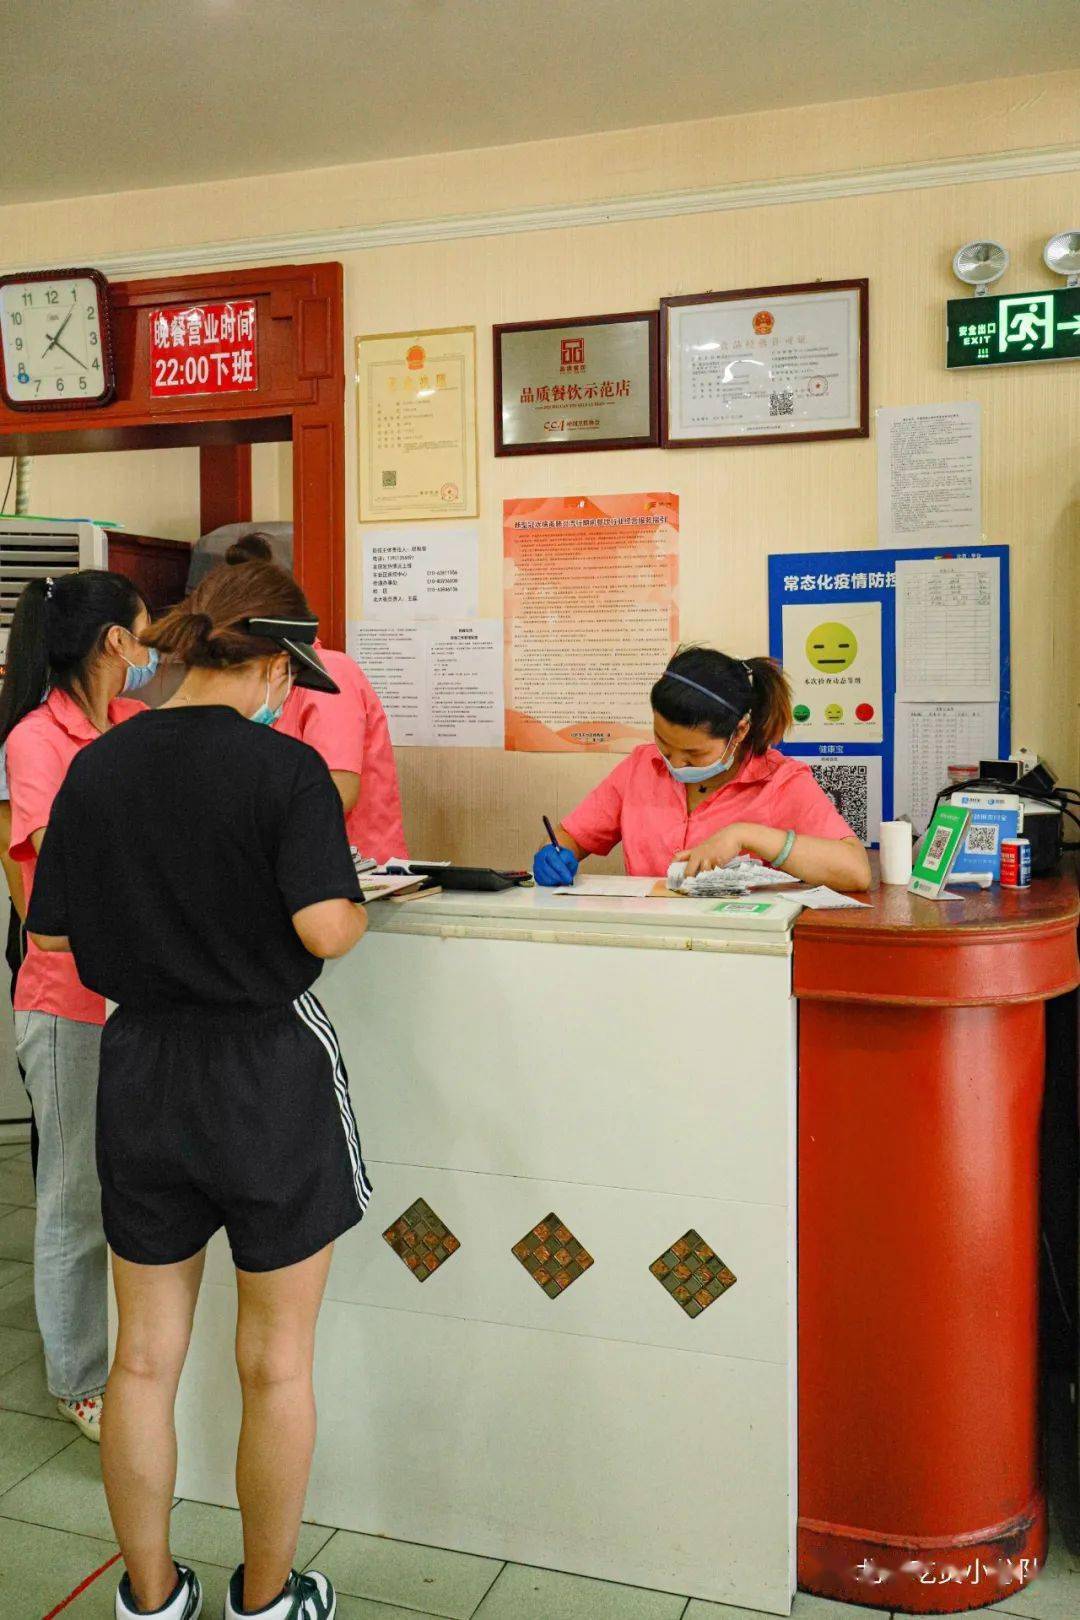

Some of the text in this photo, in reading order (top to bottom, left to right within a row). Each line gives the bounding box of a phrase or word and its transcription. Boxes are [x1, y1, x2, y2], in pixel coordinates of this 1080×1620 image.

[22, 292, 34, 306] 11
[45, 290, 59, 305] 12
[11, 311, 22, 326] 10
[87, 307, 95, 319] 2
[154, 308, 255, 348] 晚餐营业时间
[958, 322, 997, 336] 安全出口
[15, 338, 23, 351] 9
[89, 332, 98, 345] 3
[963, 335, 991, 346] EXIT
[91, 358, 100, 371] 4
[155, 349, 253, 387] 22:00下班
[33, 380, 42, 393] 7
[56, 379, 65, 392] 6
[79, 376, 87, 390] 5
[519, 379, 631, 404] 品质餐饮示范店
